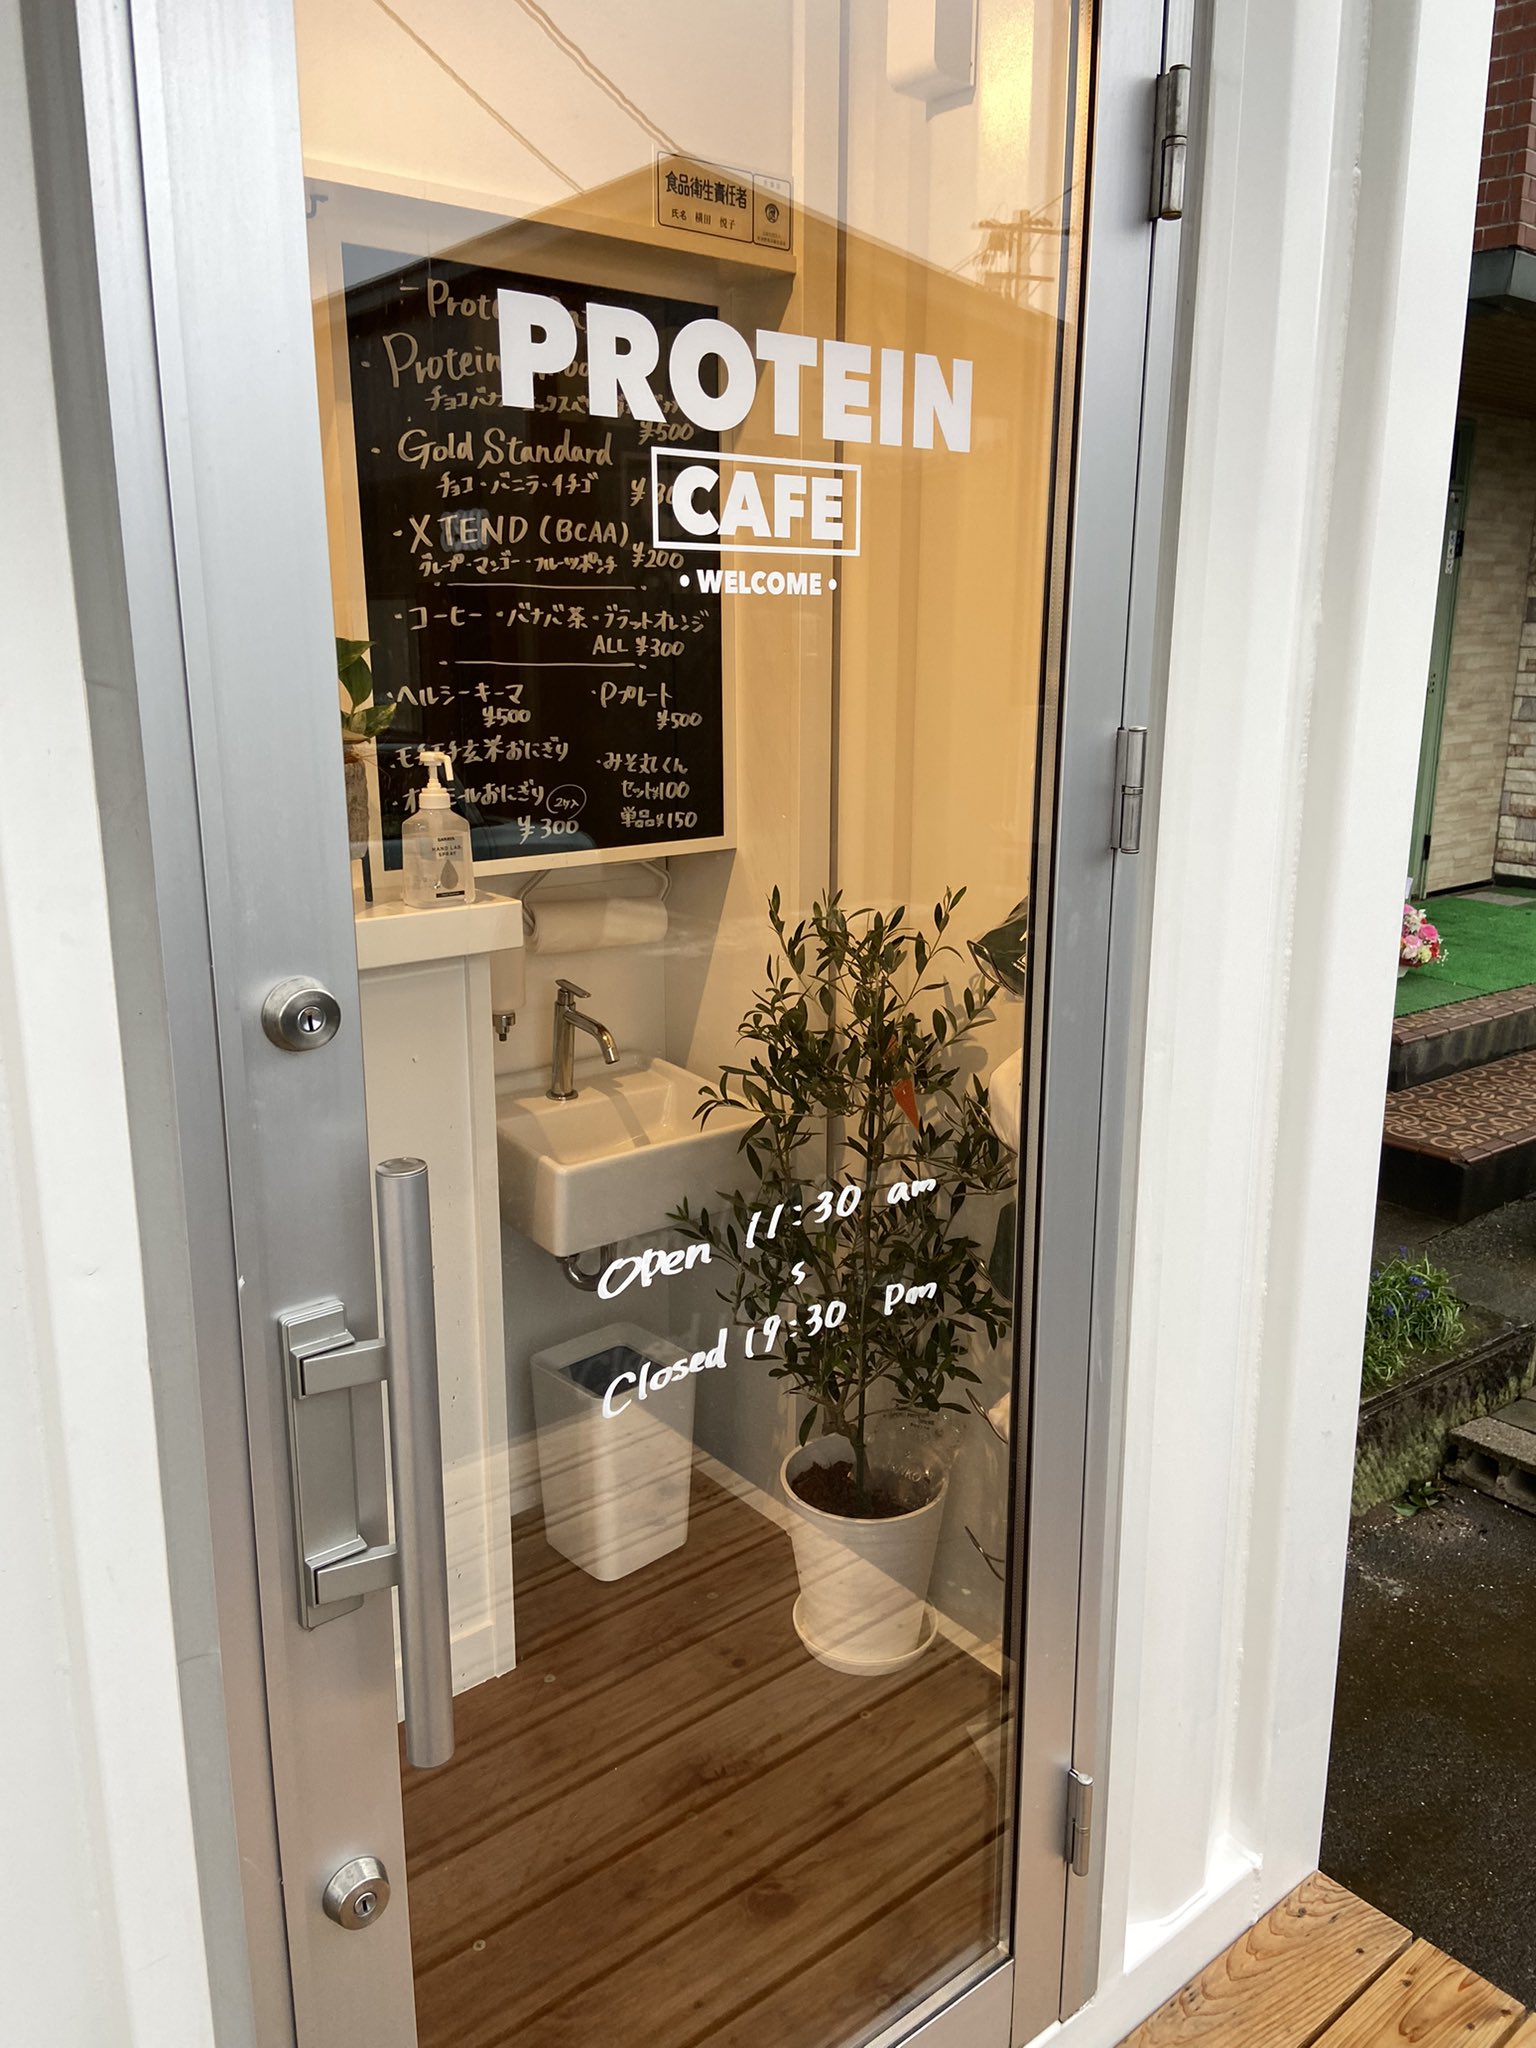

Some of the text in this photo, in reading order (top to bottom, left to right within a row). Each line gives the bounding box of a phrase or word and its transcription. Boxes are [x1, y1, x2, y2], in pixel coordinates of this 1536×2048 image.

[665, 171, 747, 209] 食品衛生責任者
[671, 208, 687, 221] 氏名
[497, 288, 973, 453] PROTEIN
[398, 427, 613, 470] Gold Standard
[672, 465, 843, 541] CAFE
[539, 514, 630, 548] (BCAA)
[632, 541, 684, 569] ¥200
[696, 569, 822, 596] WELCOME
[592, 634, 685, 658] ALL ¥300
[481, 705, 532, 728] ¥500
[656, 709, 703, 731] ¥500
[517, 815, 579, 845] ¥300
[598, 1178, 937, 1299] Open 11:30 am
[602, 1328, 728, 1419] Closed
[744, 1300, 847, 1359] 19:30
